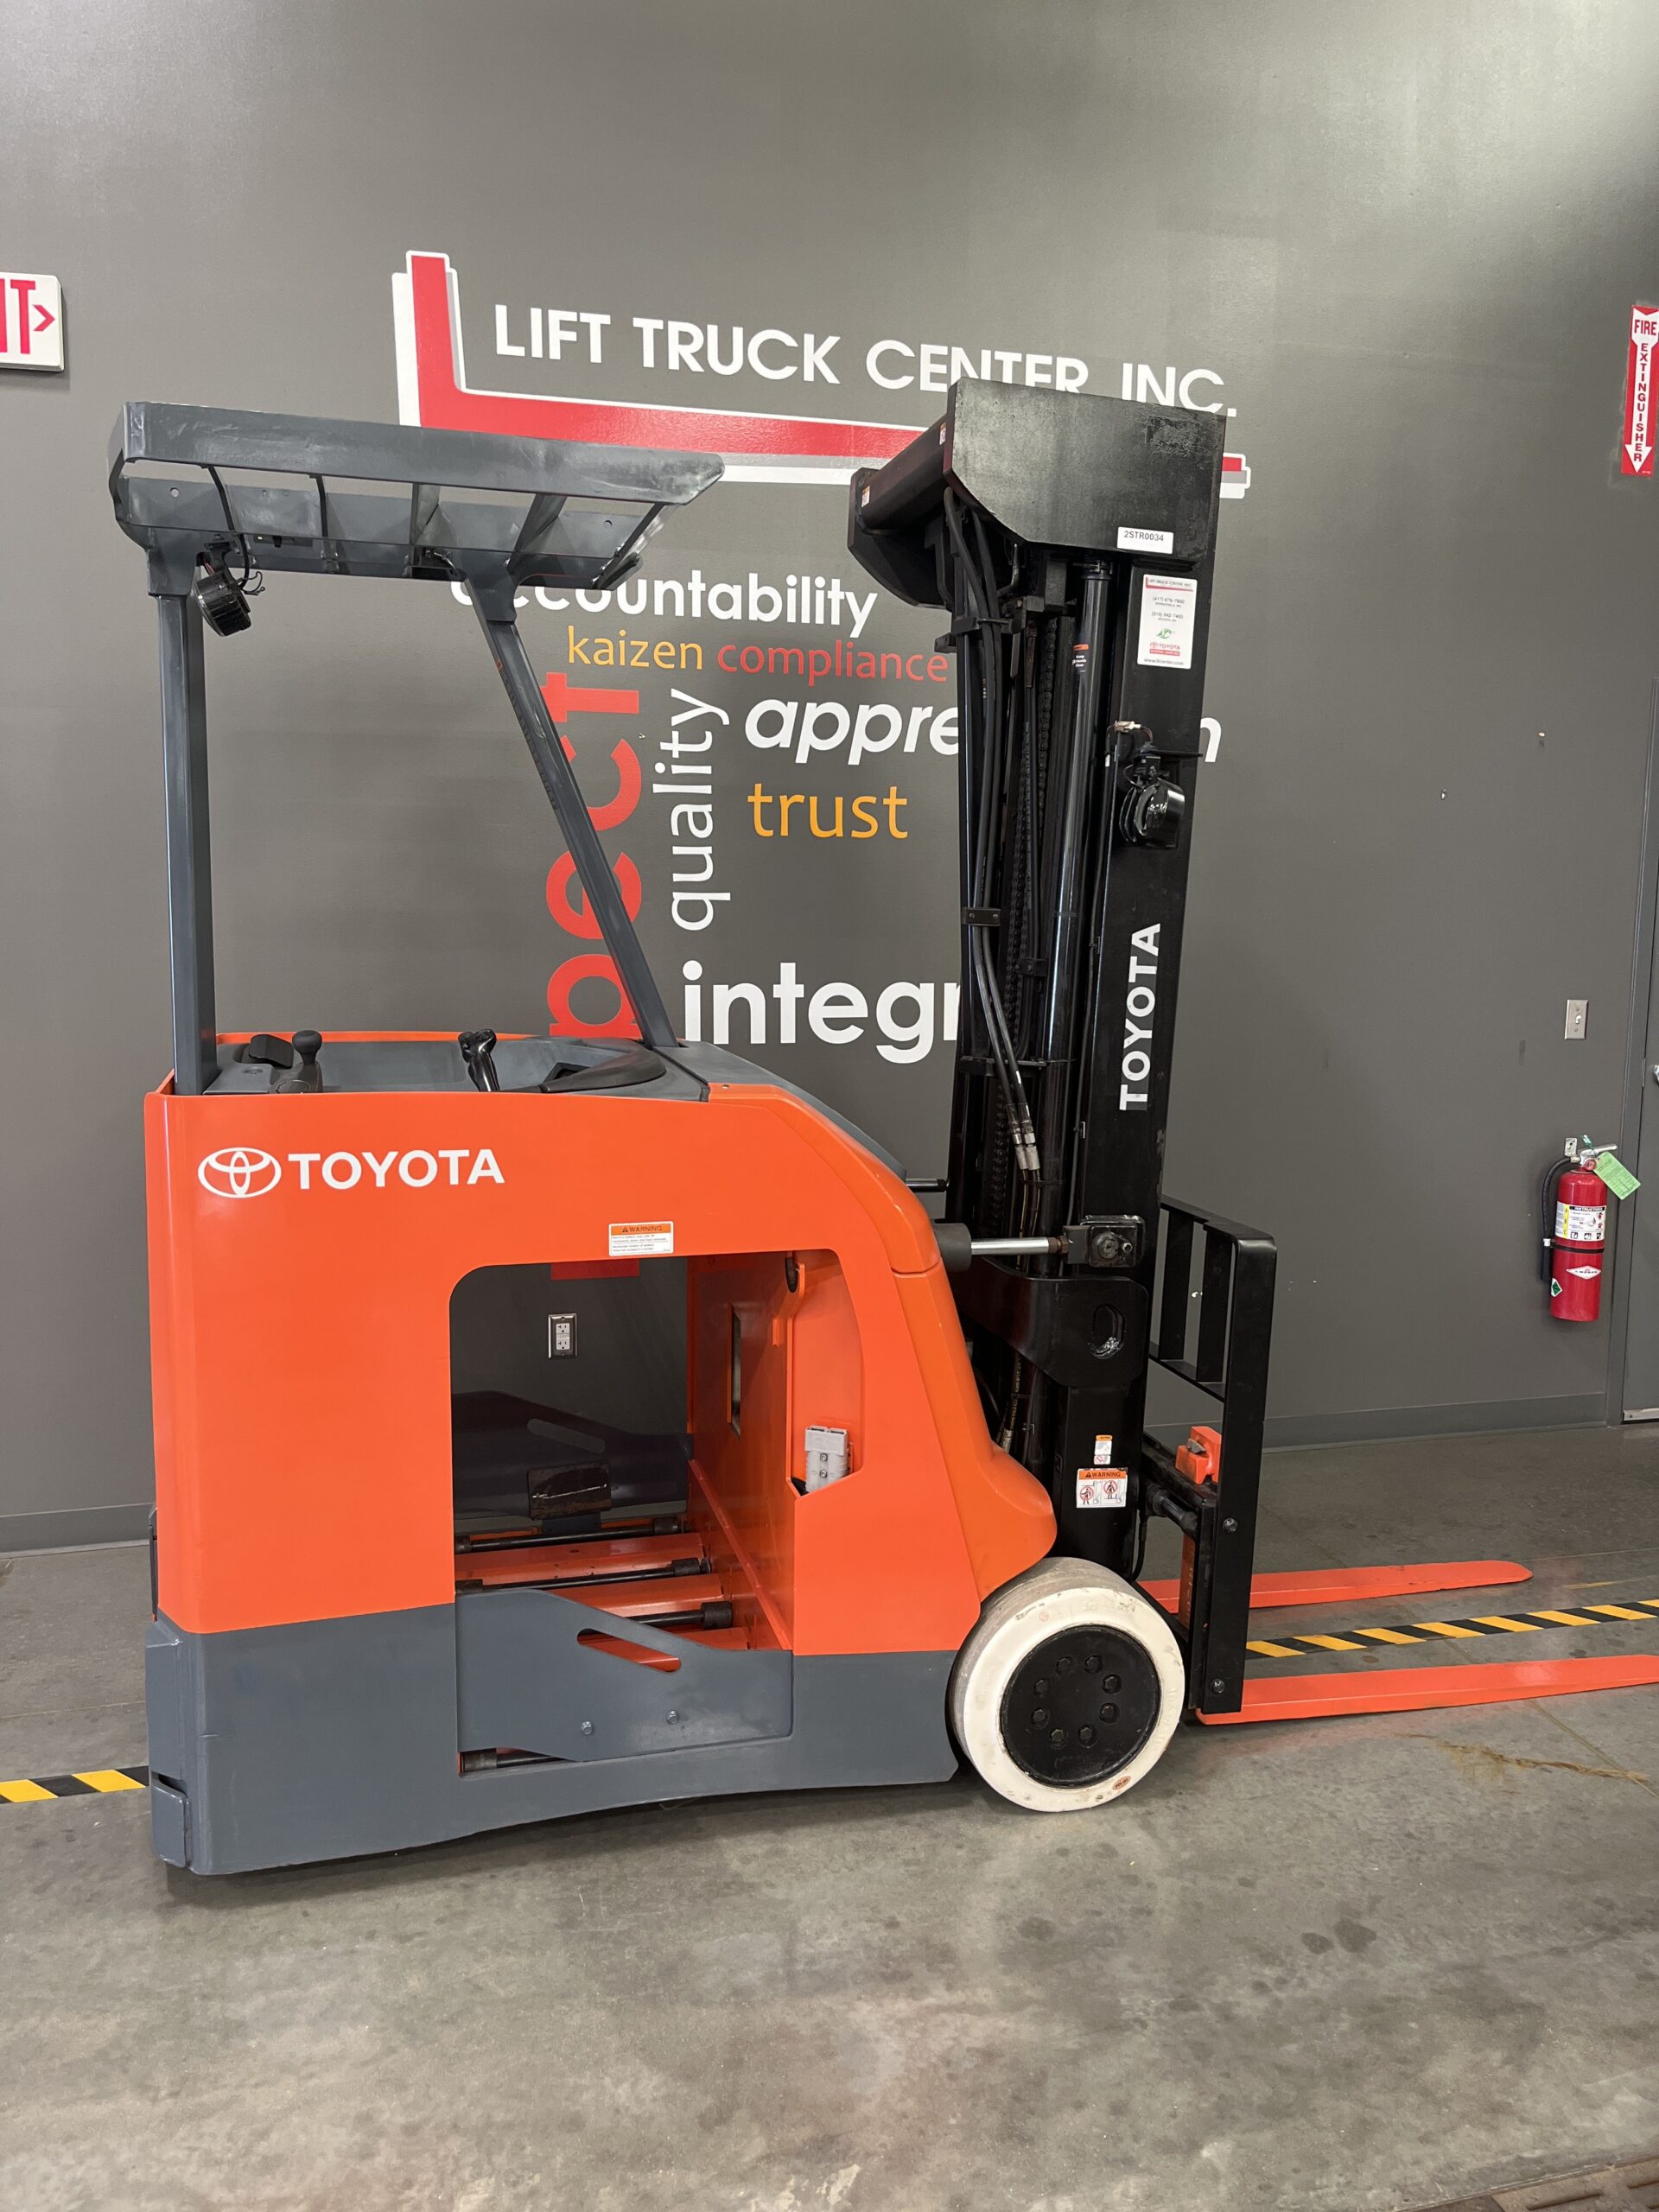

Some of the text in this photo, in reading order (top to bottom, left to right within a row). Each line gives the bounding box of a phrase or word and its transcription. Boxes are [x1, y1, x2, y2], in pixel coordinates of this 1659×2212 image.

[495, 304, 611, 364] LIFT
[632, 317, 841, 384] TRUCK
[1122, 363, 1236, 417] INC.
[1634, 320, 1657, 336] FIRE
[1633, 343, 1649, 462] EXTINGUISHER
[1124, 531, 1164, 542] 2STR0034
[450, 569, 878, 639] countability
[568, 625, 948, 687] kaizen compliance
[652, 688, 731, 931] quality
[747, 783, 907, 838] trust
[683, 960, 960, 1064] integr
[1119, 923, 1160, 1110] TOYOTA
[288, 1148, 505, 1190] TOYOTA
